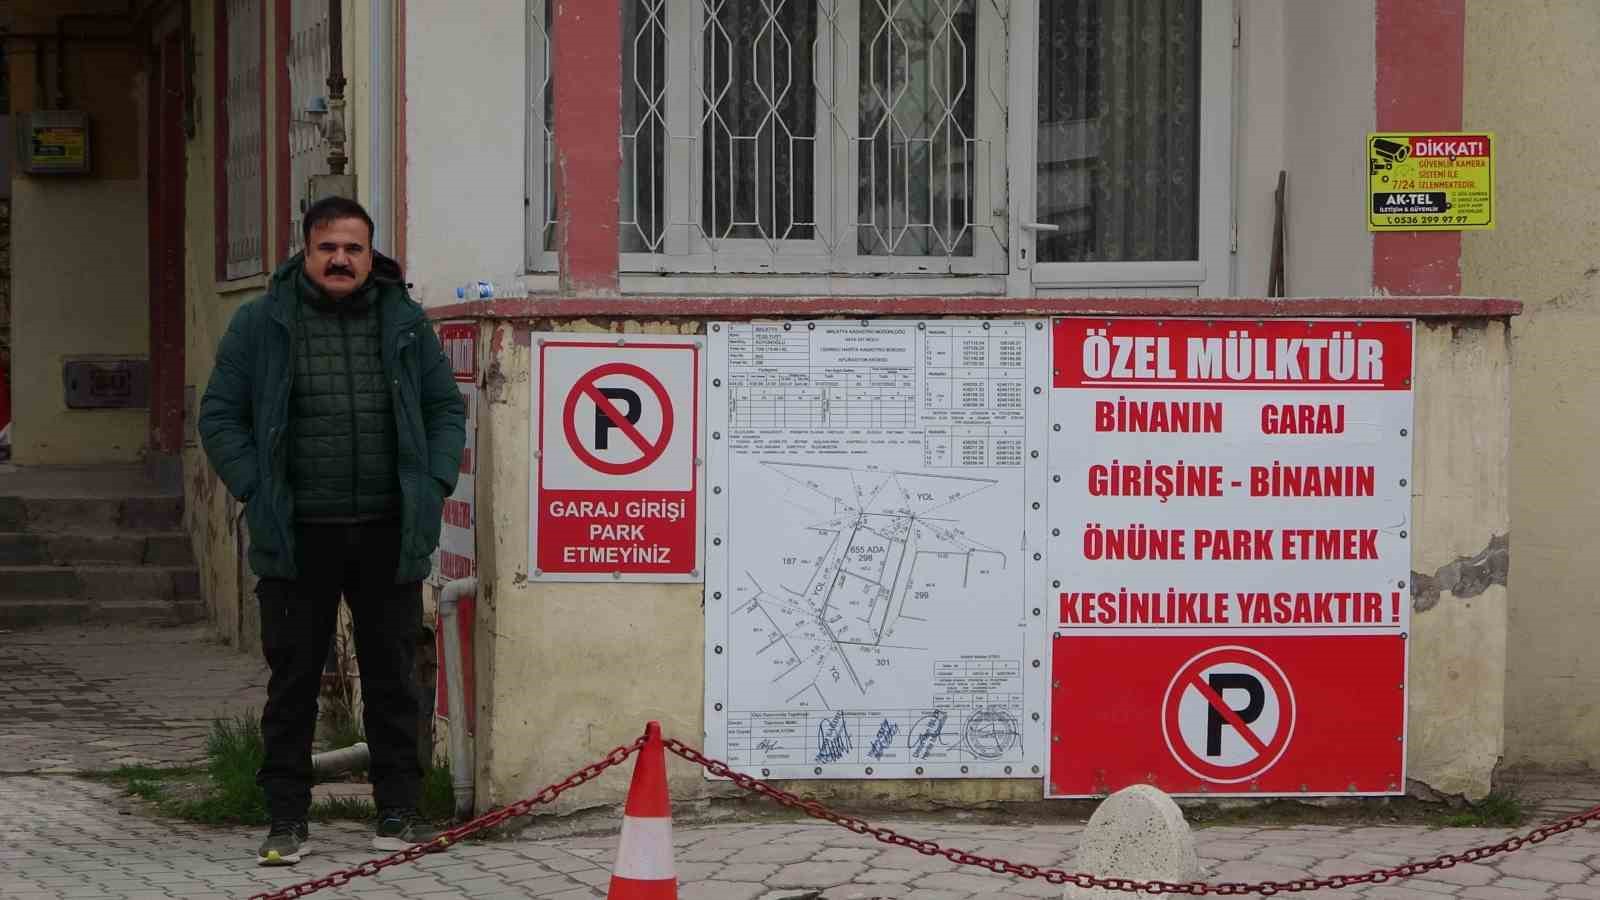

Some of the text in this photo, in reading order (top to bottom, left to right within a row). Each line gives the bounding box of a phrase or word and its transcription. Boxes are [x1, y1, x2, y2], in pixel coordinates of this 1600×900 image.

[1415, 139, 1483, 156] DİKKAT!
[1455, 159, 1486, 168] KAMERA
[1392, 180, 1416, 190] 7/24
[1385, 194, 1433, 205] AK-TEL
[1394, 216, 1468, 224] 0536 299 97 97
[1082, 329, 1176, 379] ÖZEL
[1187, 330, 1385, 381] MÜLKTÜR
[1095, 396, 1345, 435] BİNANIN GARAJ
[1088, 459, 1224, 504] GİRİŞİNE
[1250, 460, 1375, 497] BİNANIN
[549, 498, 686, 522] GARAJ GİRİŞİ
[589, 524, 645, 541] PARK
[850, 545, 885, 553] 655 ADA
[1083, 523, 1379, 560] ÖNÜNE PARK ETMEK
[563, 544, 671, 564] ETMEYİNİZ
[1059, 587, 1229, 624] KESİNLİKLE
[1236, 591, 1383, 624] YASAKTIR
[876, 658, 891, 666] 301
